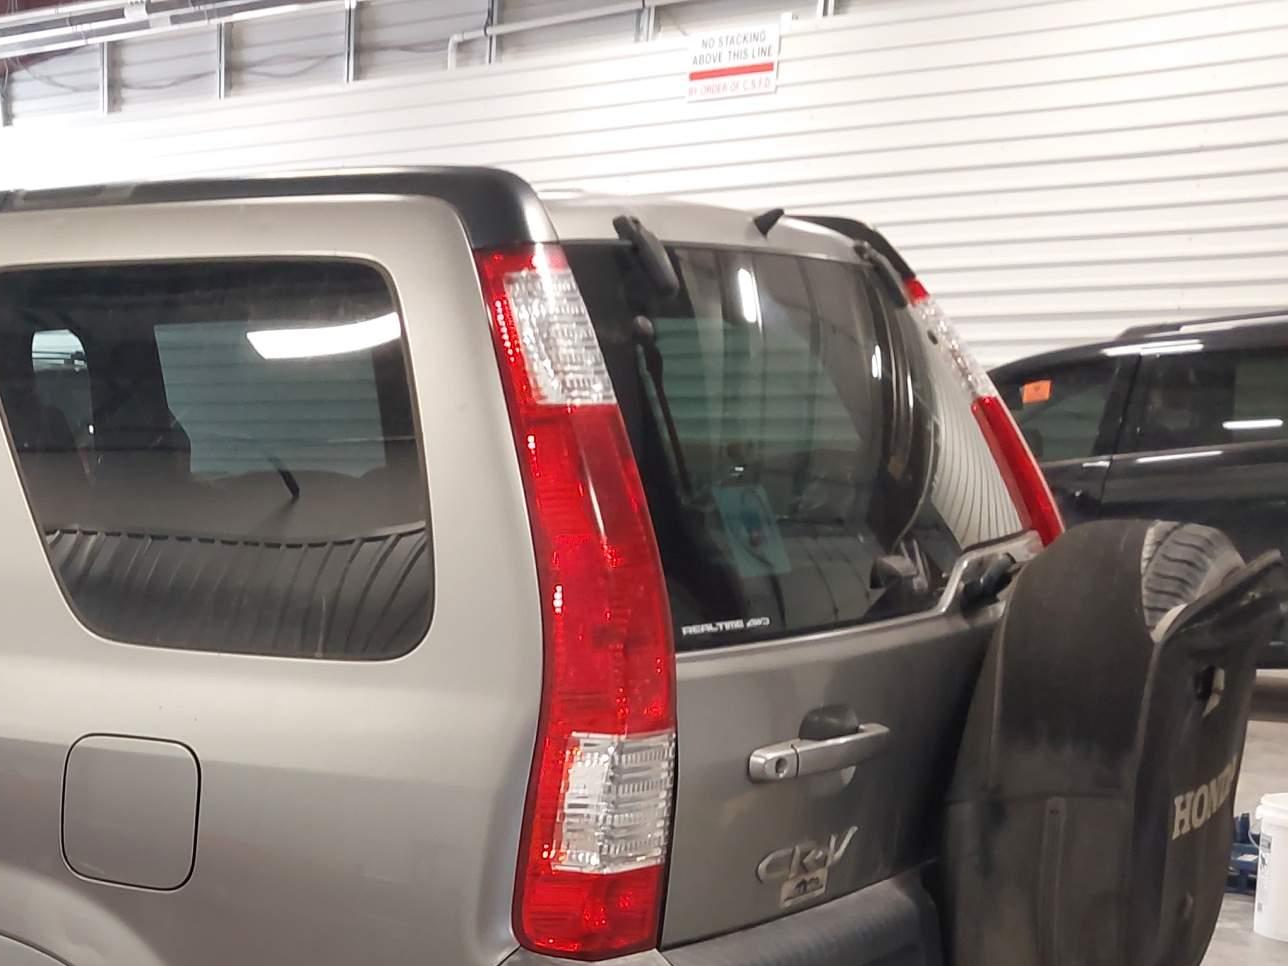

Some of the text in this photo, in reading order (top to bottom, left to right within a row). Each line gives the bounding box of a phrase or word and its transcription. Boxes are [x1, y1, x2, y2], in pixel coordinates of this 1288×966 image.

[702, 30, 766, 49] NO STACKING
[693, 45, 772, 65] ABOVE THIS LINE
